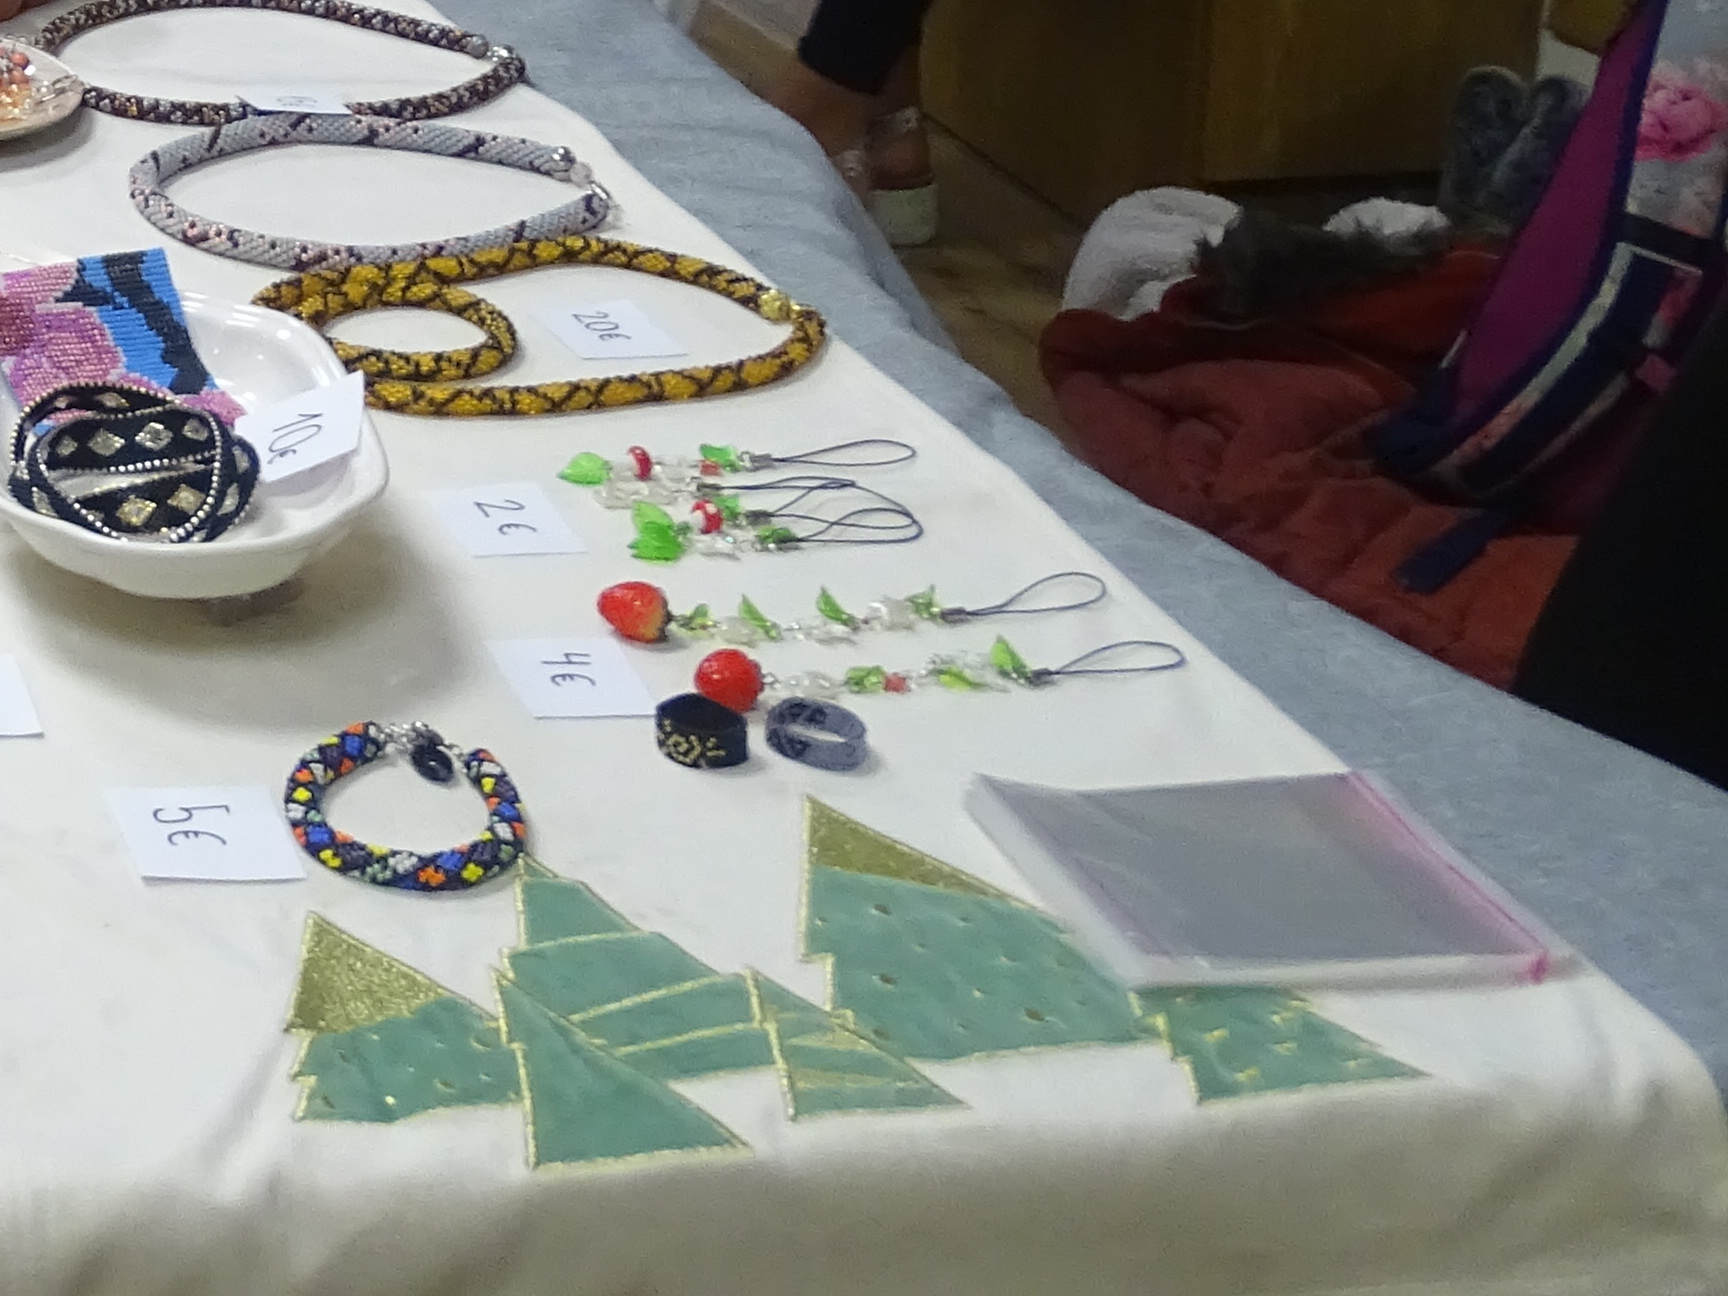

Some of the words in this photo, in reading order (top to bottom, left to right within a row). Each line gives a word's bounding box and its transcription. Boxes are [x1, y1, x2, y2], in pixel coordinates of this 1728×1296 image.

[571, 310, 632, 341] 20€
[266, 412, 324, 465] 10€
[473, 499, 538, 535] 2€
[540, 652, 597, 687] 4€
[152, 804, 231, 846] 5€
